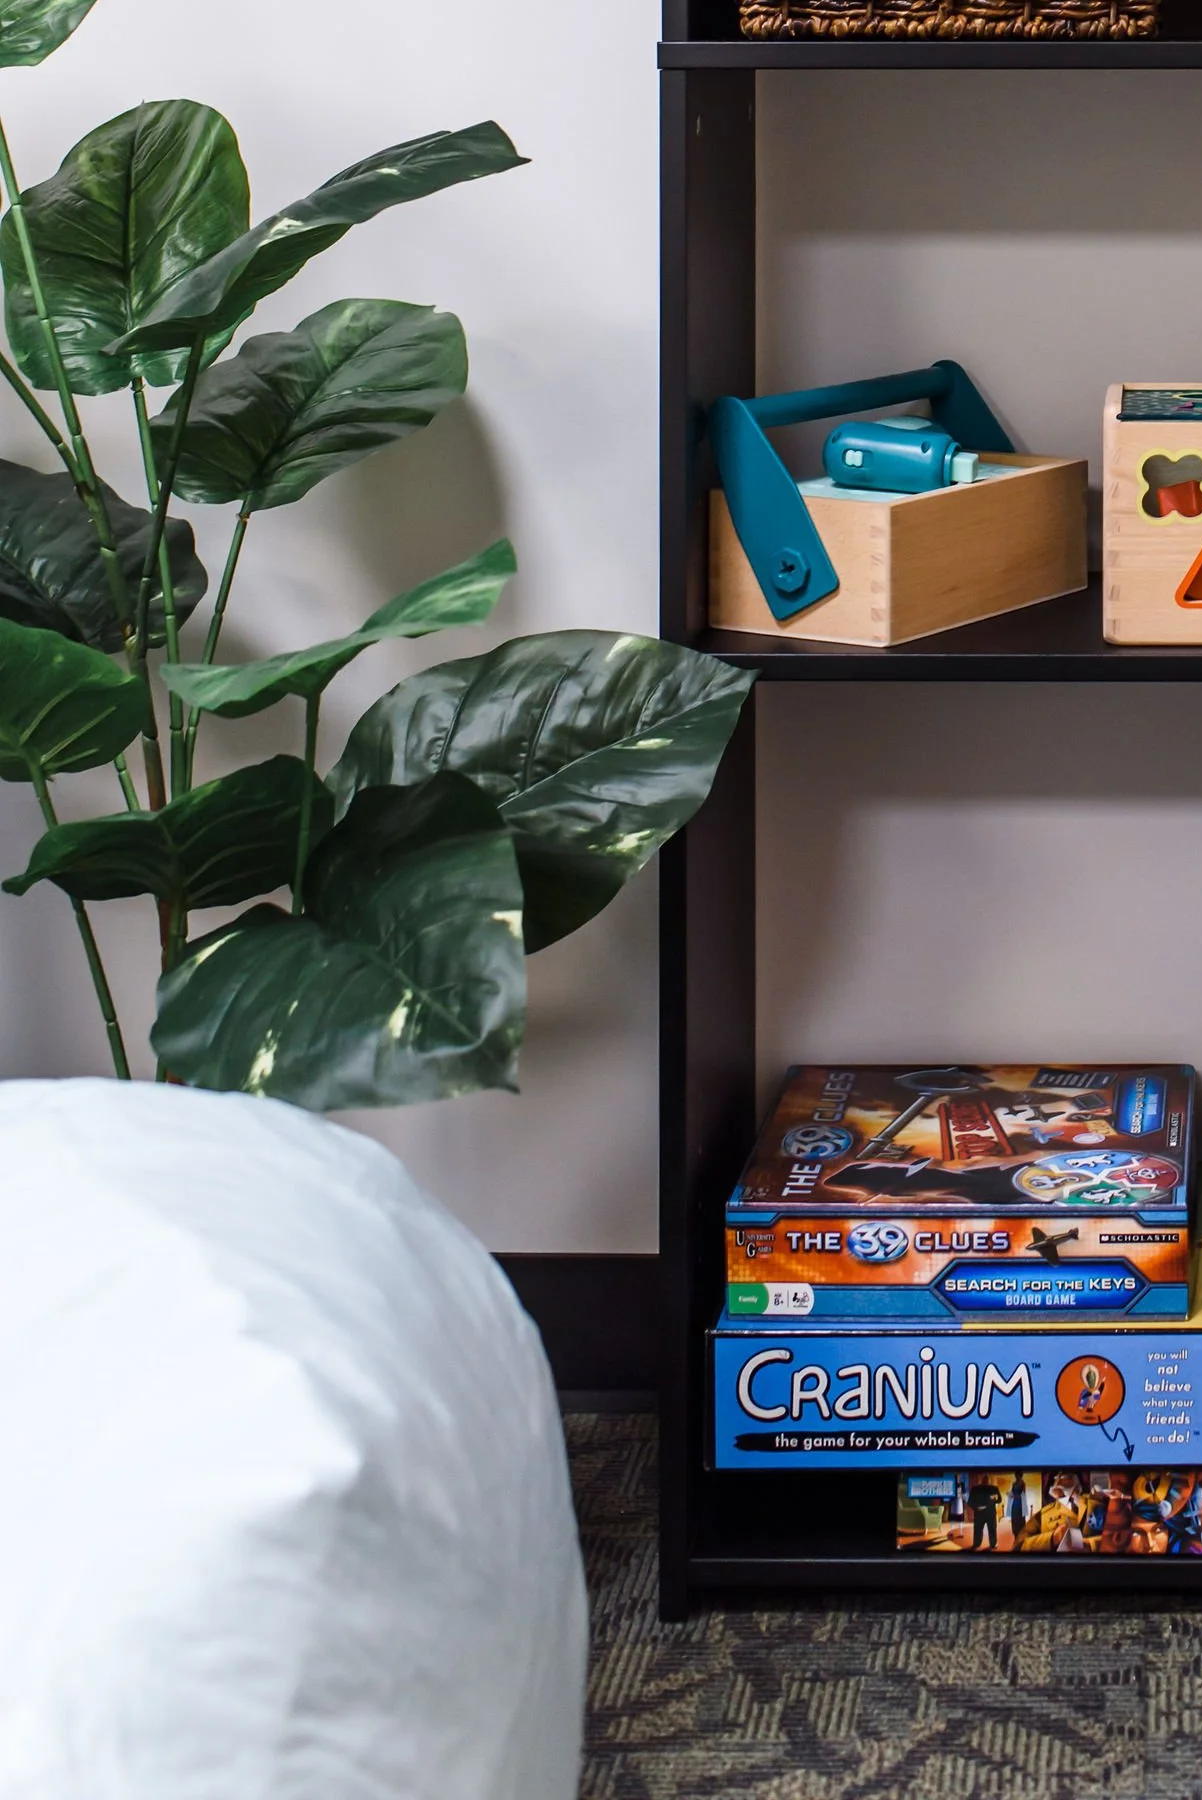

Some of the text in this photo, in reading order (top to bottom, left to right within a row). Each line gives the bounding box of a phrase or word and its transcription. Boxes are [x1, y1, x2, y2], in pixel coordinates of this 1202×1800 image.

[782, 1072, 855, 1197] THE 39 CLUES
[787, 1224, 1009, 1258] THE 39 CLUES
[1110, 1234, 1179, 1242] SCHOLASTIC
[945, 1278, 1136, 1291] SEARCH FOR THE KEYS
[1005, 1293, 1076, 1306] BOARD GAME
[1148, 1350, 1188, 1362] you will
[1158, 1364, 1178, 1375] not
[1144, 1379, 1191, 1392] believe
[1142, 1398, 1193, 1409] what your
[1146, 1411, 1190, 1425] friends
[775, 1433, 798, 1447] the
[803, 1436, 845, 1450] game
[850, 1432, 871, 1446] for
[876, 1436, 910, 1450] your
[915, 1432, 960, 1446] whole
[1168, 1430, 1190, 1443] do!
